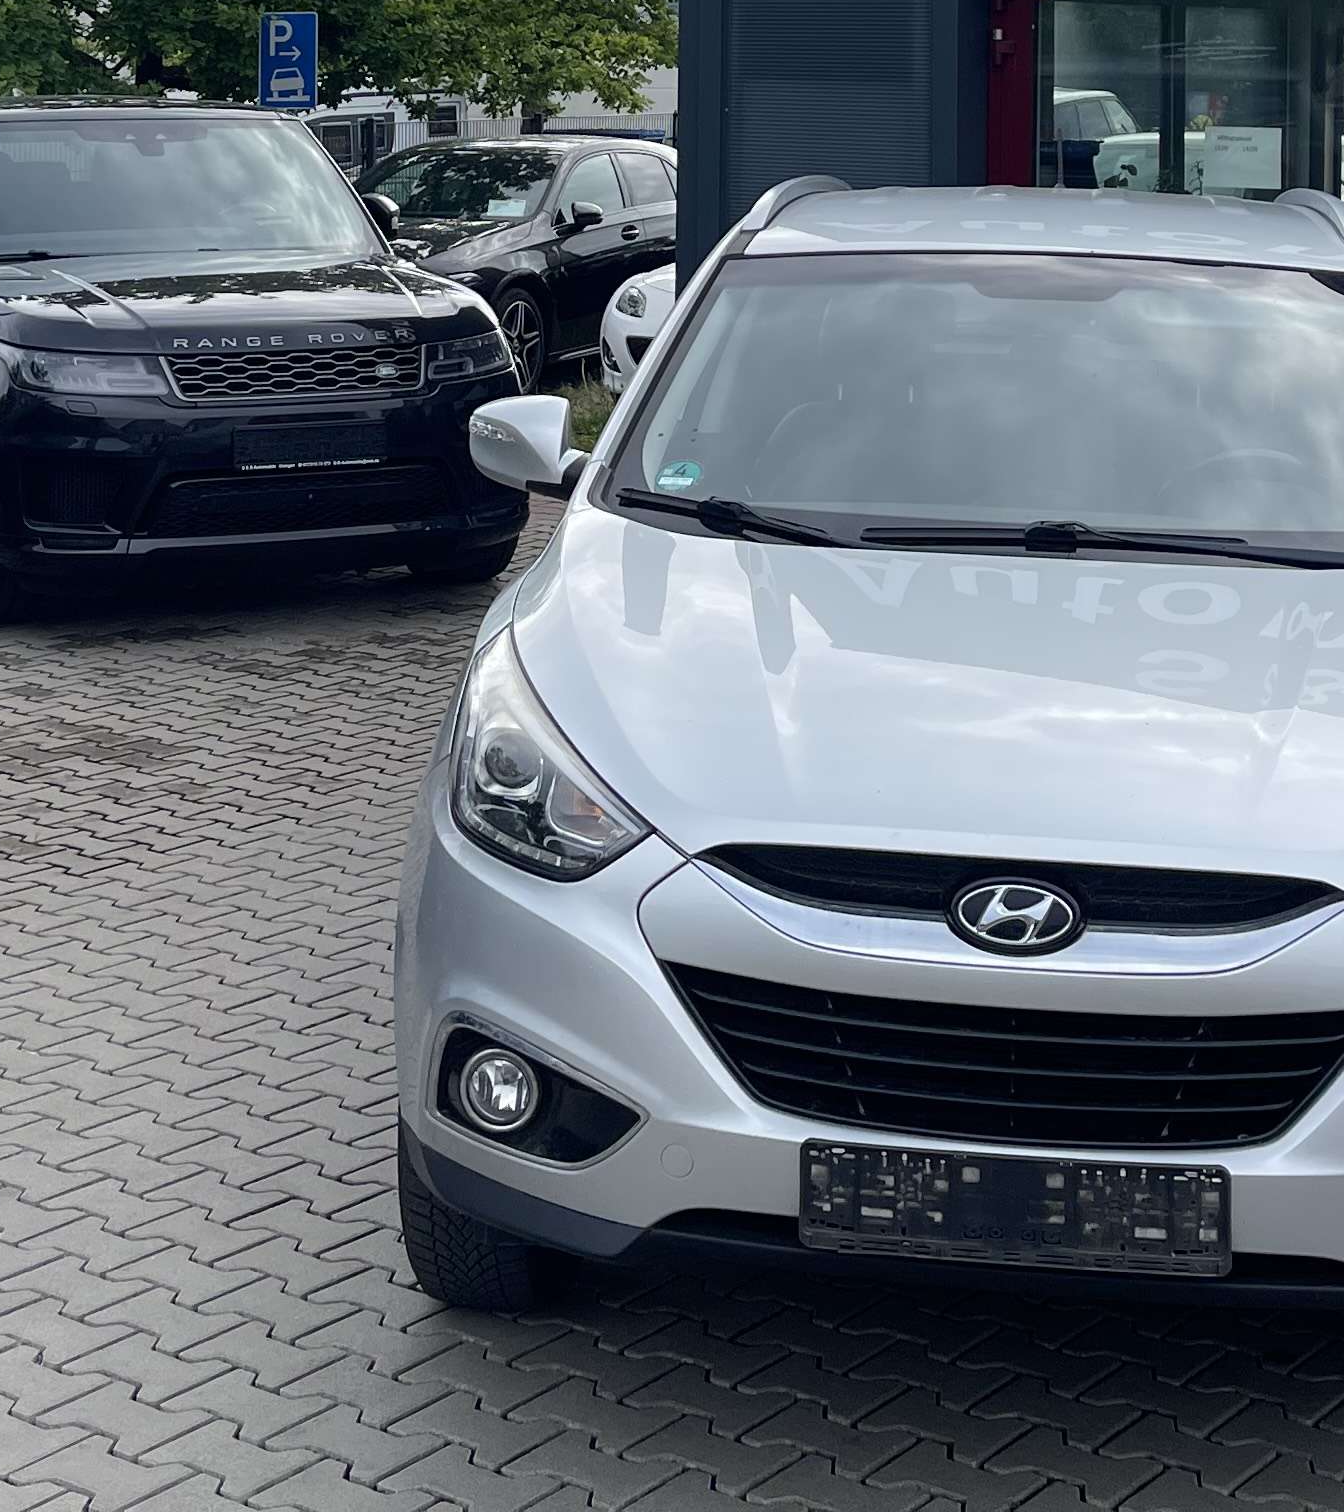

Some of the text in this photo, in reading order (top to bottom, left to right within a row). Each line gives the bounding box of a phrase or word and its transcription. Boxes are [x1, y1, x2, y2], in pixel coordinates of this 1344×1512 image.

[269, 19, 293, 57] P
[172, 328, 410, 349] RANGE ROVER
